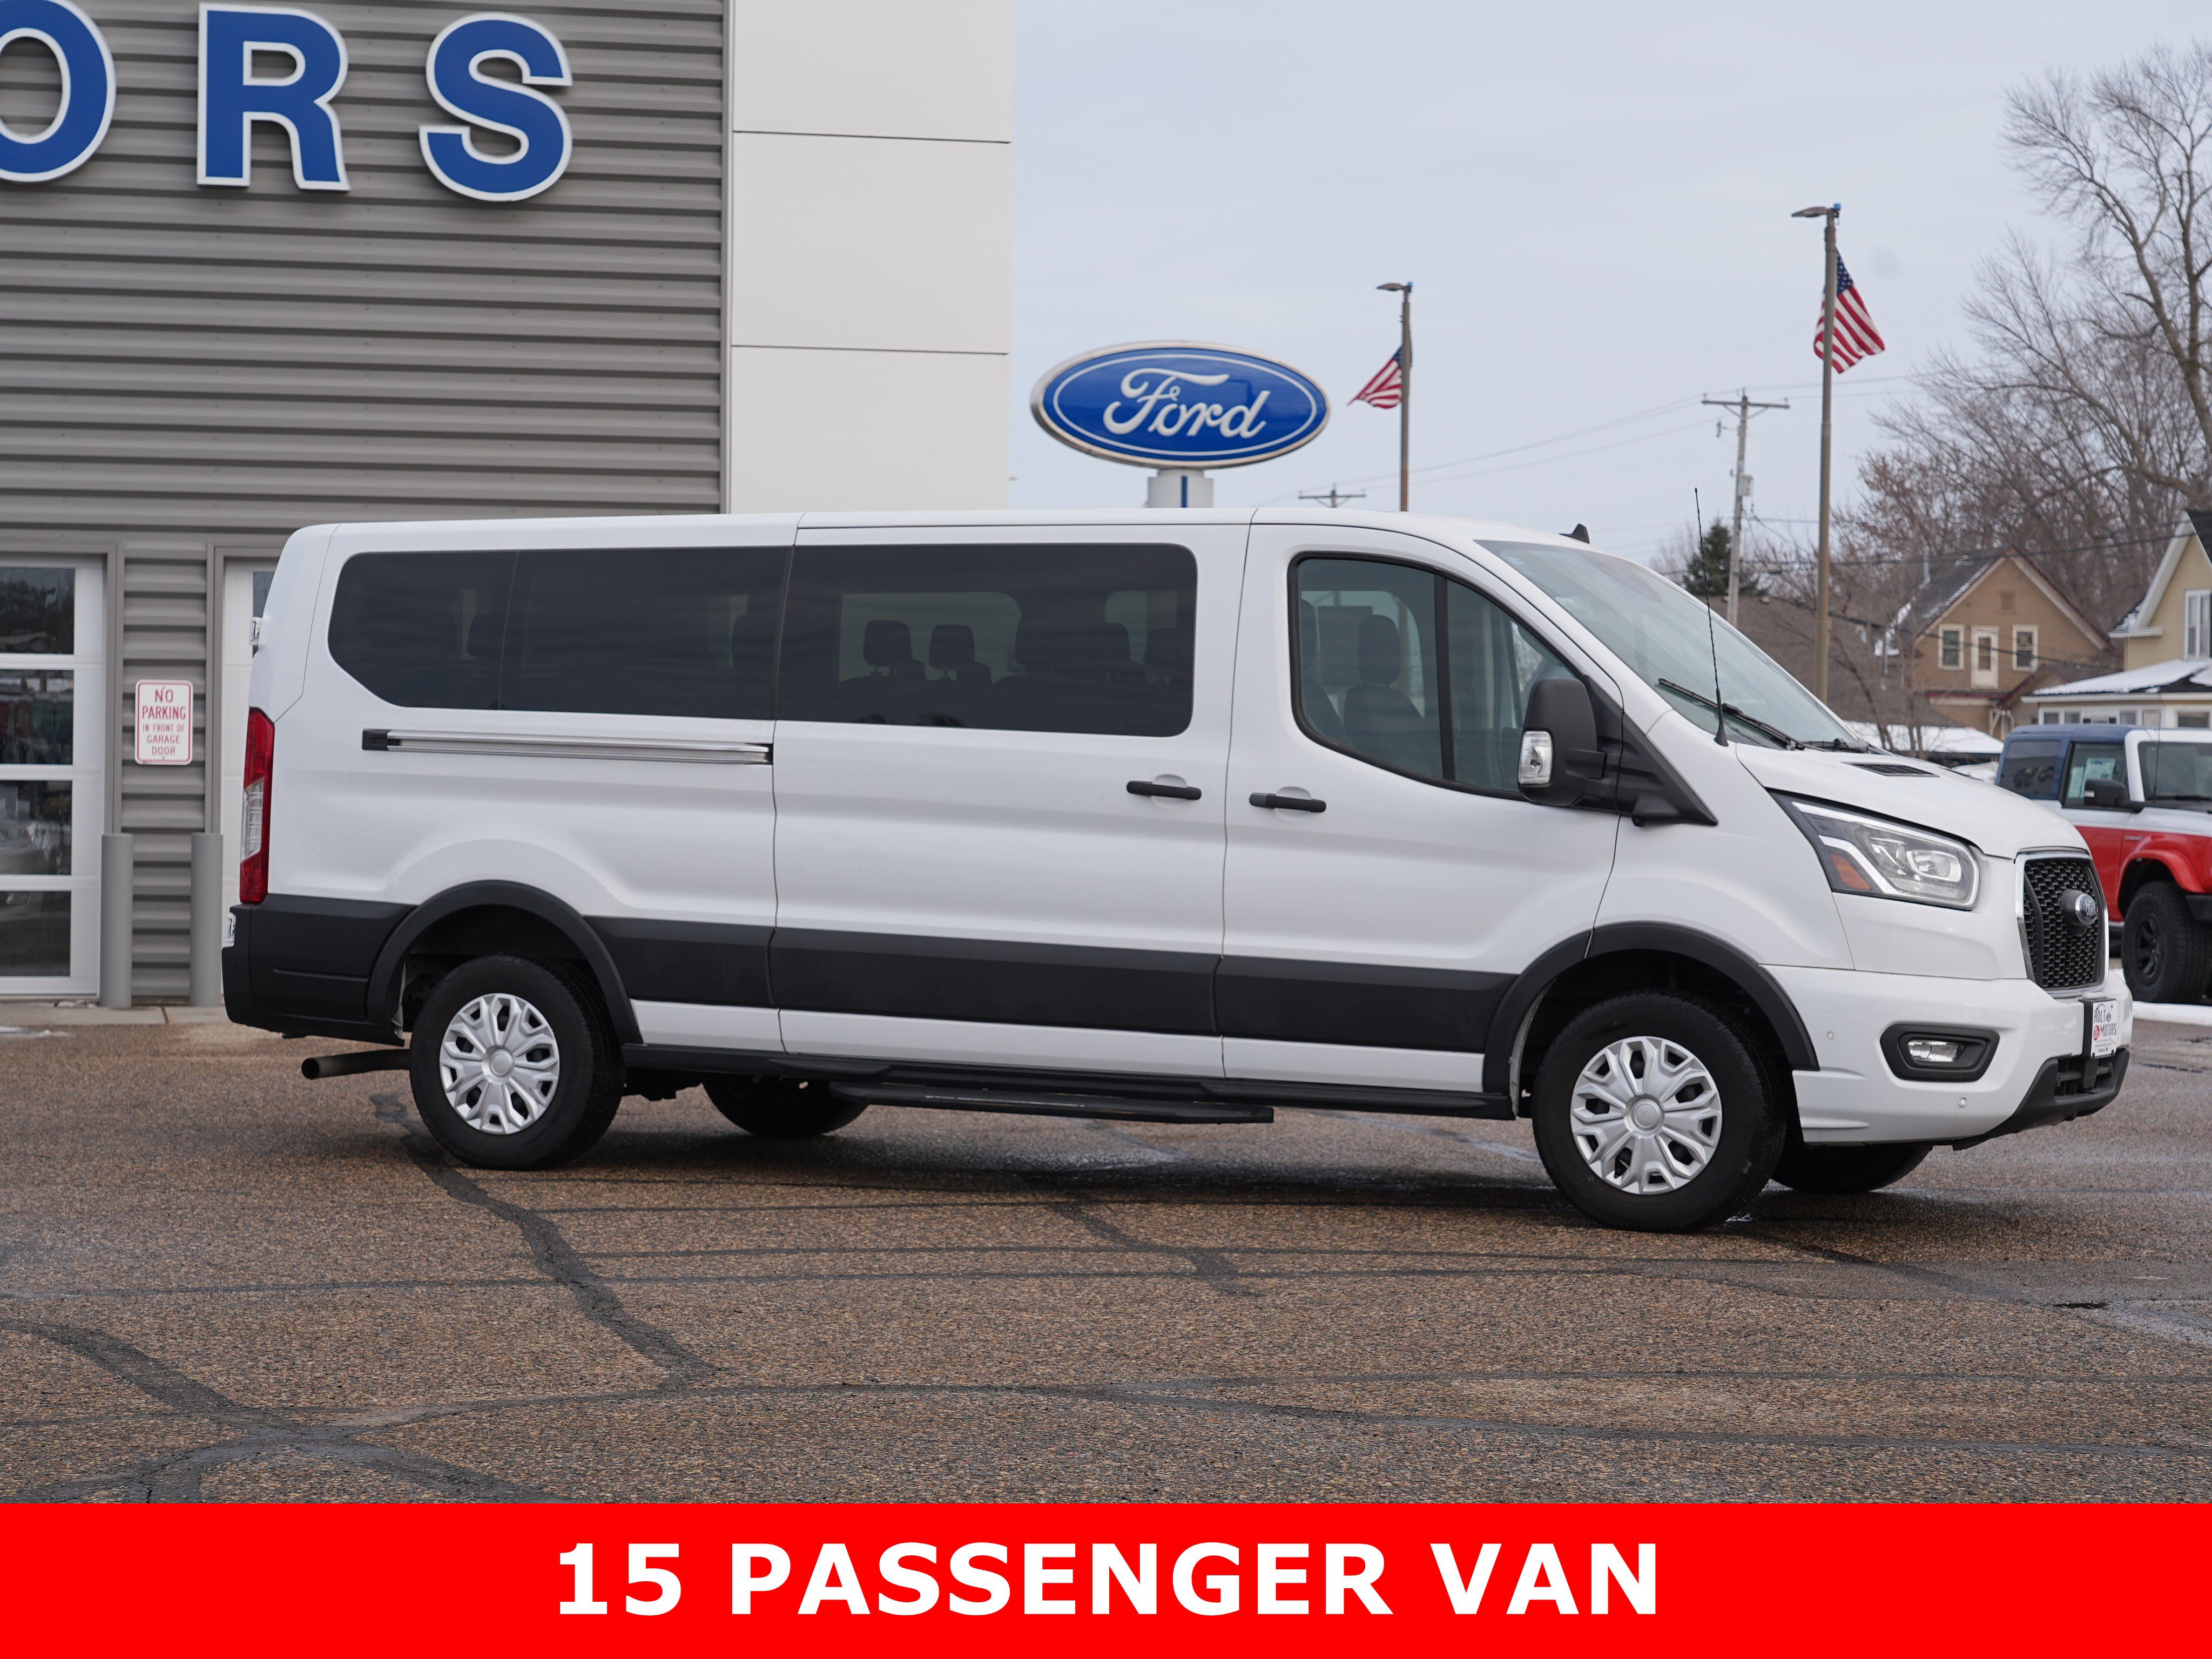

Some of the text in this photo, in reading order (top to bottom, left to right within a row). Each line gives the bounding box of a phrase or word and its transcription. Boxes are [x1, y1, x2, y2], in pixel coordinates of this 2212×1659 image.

[0, 0, 574, 202] ORS
[1103, 367, 1270, 439] Ford
[154, 689, 173, 703] NO
[142, 705, 186, 720] PARKING
[142, 723, 185, 733] IN FRONT OF
[147, 734, 181, 745] GARAGE
[151, 746, 176, 756] DOOR
[2094, 1009, 2106, 1023] HOLT
[2100, 1023, 2116, 1037] MOTORS
